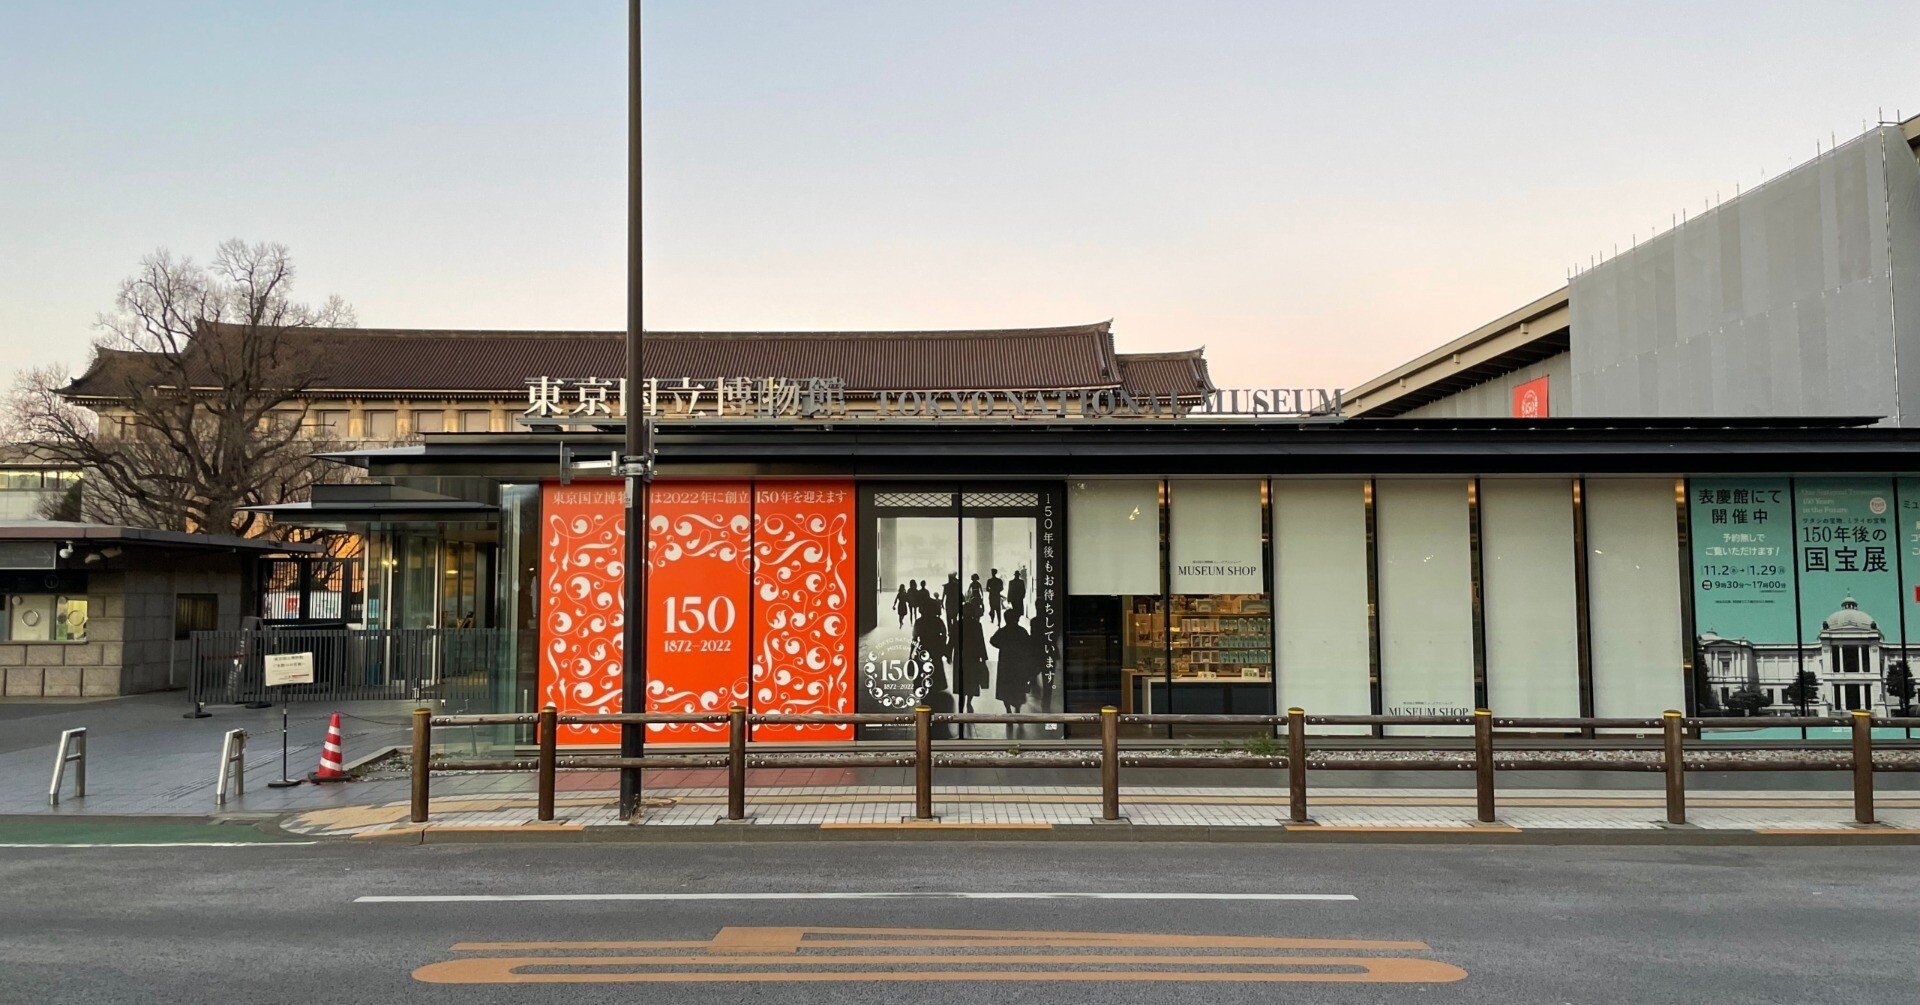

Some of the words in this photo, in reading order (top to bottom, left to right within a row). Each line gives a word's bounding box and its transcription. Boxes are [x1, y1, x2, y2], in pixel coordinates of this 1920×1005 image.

[524, 376, 846, 416] 東京国立博物館
[873, 391, 995, 415] TOKYO
[1002, 390, 1192, 415] NATIONAL
[1199, 388, 1345, 414] MUSEUM
[1698, 488, 1782, 504] 表慶館にて
[1711, 508, 1768, 524] 開催中
[1803, 525, 1887, 542] 150年後の
[1804, 546, 1889, 572] 国宝展
[1178, 566, 1224, 576] MUSEUM
[1227, 566, 1257, 576] SHOP
[663, 595, 736, 634] 150
[880, 659, 919, 681] 150
[1388, 707, 1436, 716] MUSEUM
[1439, 707, 1469, 716] SHOP
